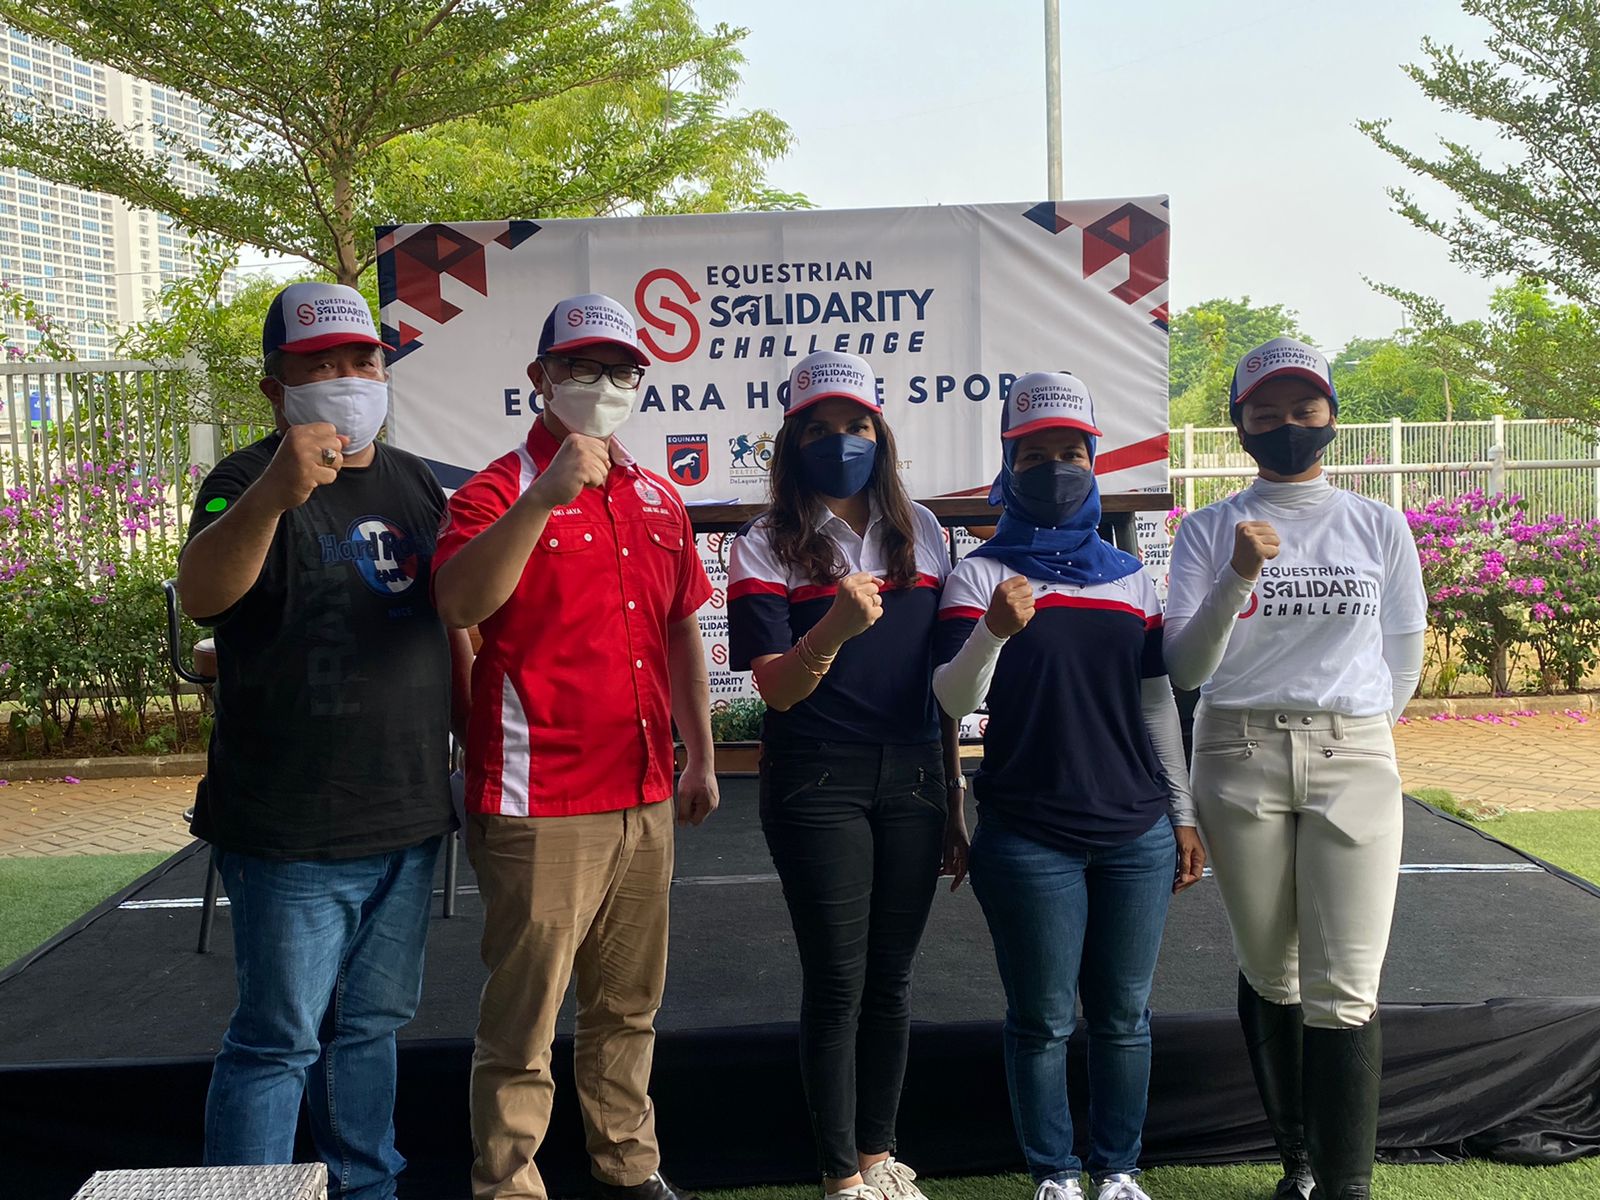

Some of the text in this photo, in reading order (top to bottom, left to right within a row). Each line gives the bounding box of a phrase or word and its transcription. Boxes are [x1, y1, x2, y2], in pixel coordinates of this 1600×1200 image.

[706, 260, 872, 289] EQUESTRIAN
[314, 299, 358, 307] EQUESTRIAN
[709, 288, 935, 328] SOLIDARITY
[317, 306, 368, 320] SOLIDARITY
[709, 330, 925, 360] CHALLENGE
[1262, 347, 1305, 355] EQUESTRIAN
[1263, 352, 1317, 364] SOLIDARITY
[811, 362, 853, 371] EQUESTRIAN
[812, 369, 865, 381] SOLIDARITY
[1031, 386, 1072, 394] EQUESTRIAN
[1032, 392, 1084, 404] SOLIDARITY
[667, 435, 706, 443] EQUINARA
[318, 531, 380, 563] Hard
[1261, 566, 1355, 579] EQUESTRIAN
[1263, 580, 1377, 599] SOLIDARITY
[1263, 602, 1377, 617] CHALLENGE
[709, 676, 744, 686] IDARITY
